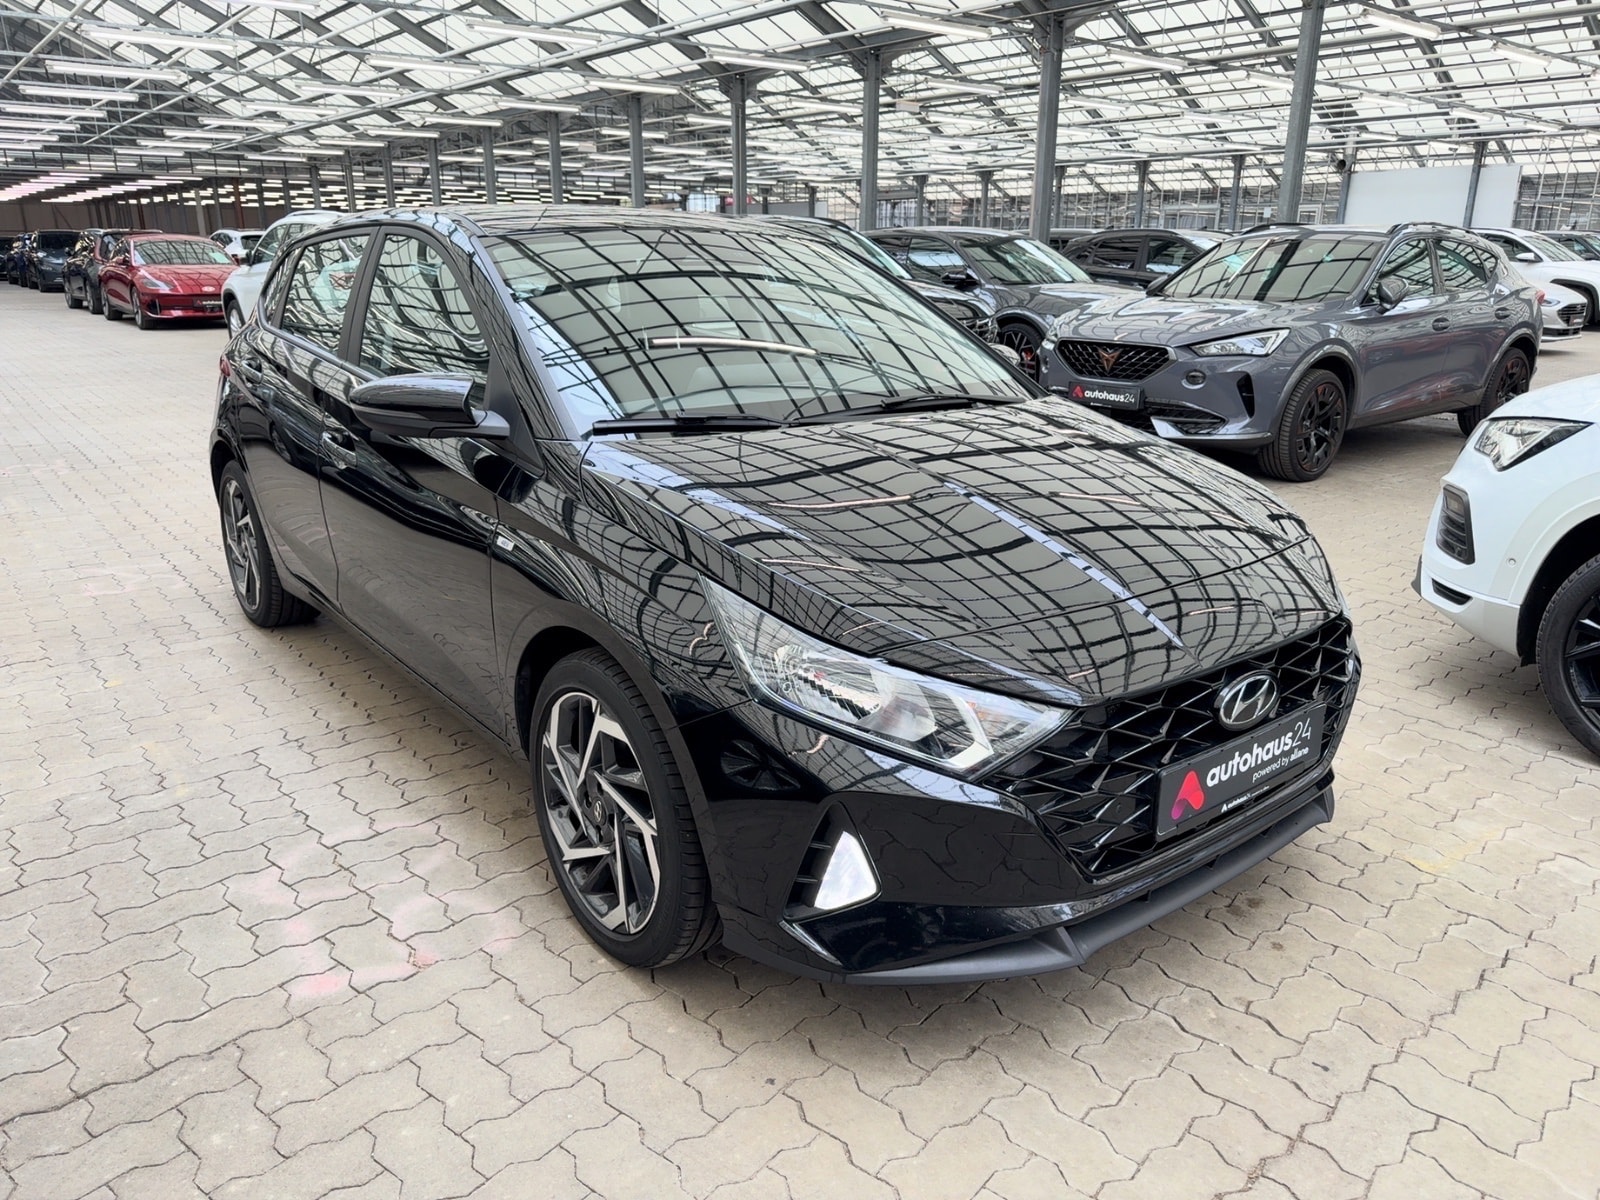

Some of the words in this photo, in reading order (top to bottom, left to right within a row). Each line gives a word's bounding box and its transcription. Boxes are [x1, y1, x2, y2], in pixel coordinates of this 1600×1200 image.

[1084, 389, 1135, 404] autohaus24
[1206, 717, 1312, 787] autohaus24
[1252, 758, 1281, 783] powered
[1281, 756, 1290, 767] by
